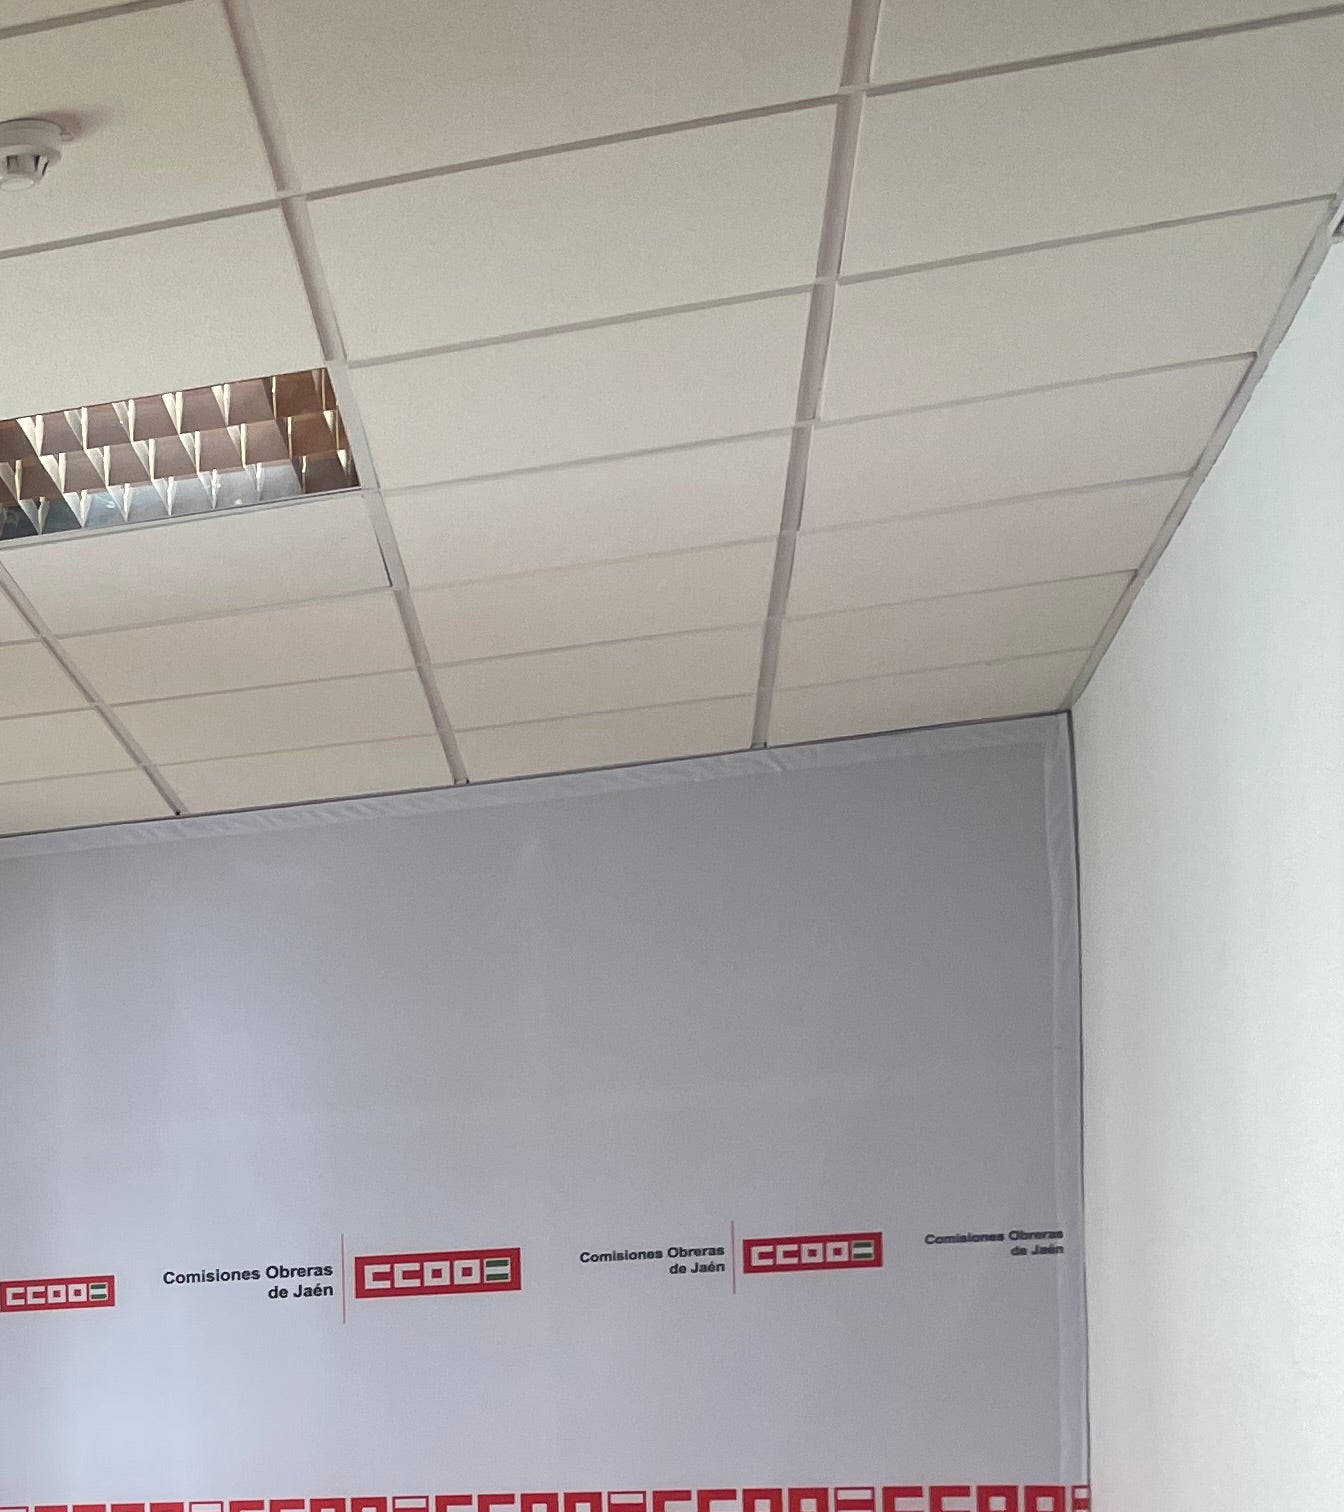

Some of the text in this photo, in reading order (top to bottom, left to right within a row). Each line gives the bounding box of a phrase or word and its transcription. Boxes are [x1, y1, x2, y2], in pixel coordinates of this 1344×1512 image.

[924, 1229, 1063, 1245] Comisiones Obreras
[579, 1247, 725, 1263] Comisiones Obreras
[751, 1240, 850, 1267] CCOO
[1011, 1244, 1064, 1256] de Jaén
[163, 1264, 333, 1285] Comisiones Obreras
[364, 1258, 480, 1291] CCOO
[669, 1261, 725, 1274] de Jaén
[5, 1282, 87, 1306] CCOO
[268, 1283, 334, 1299] de Jaén
